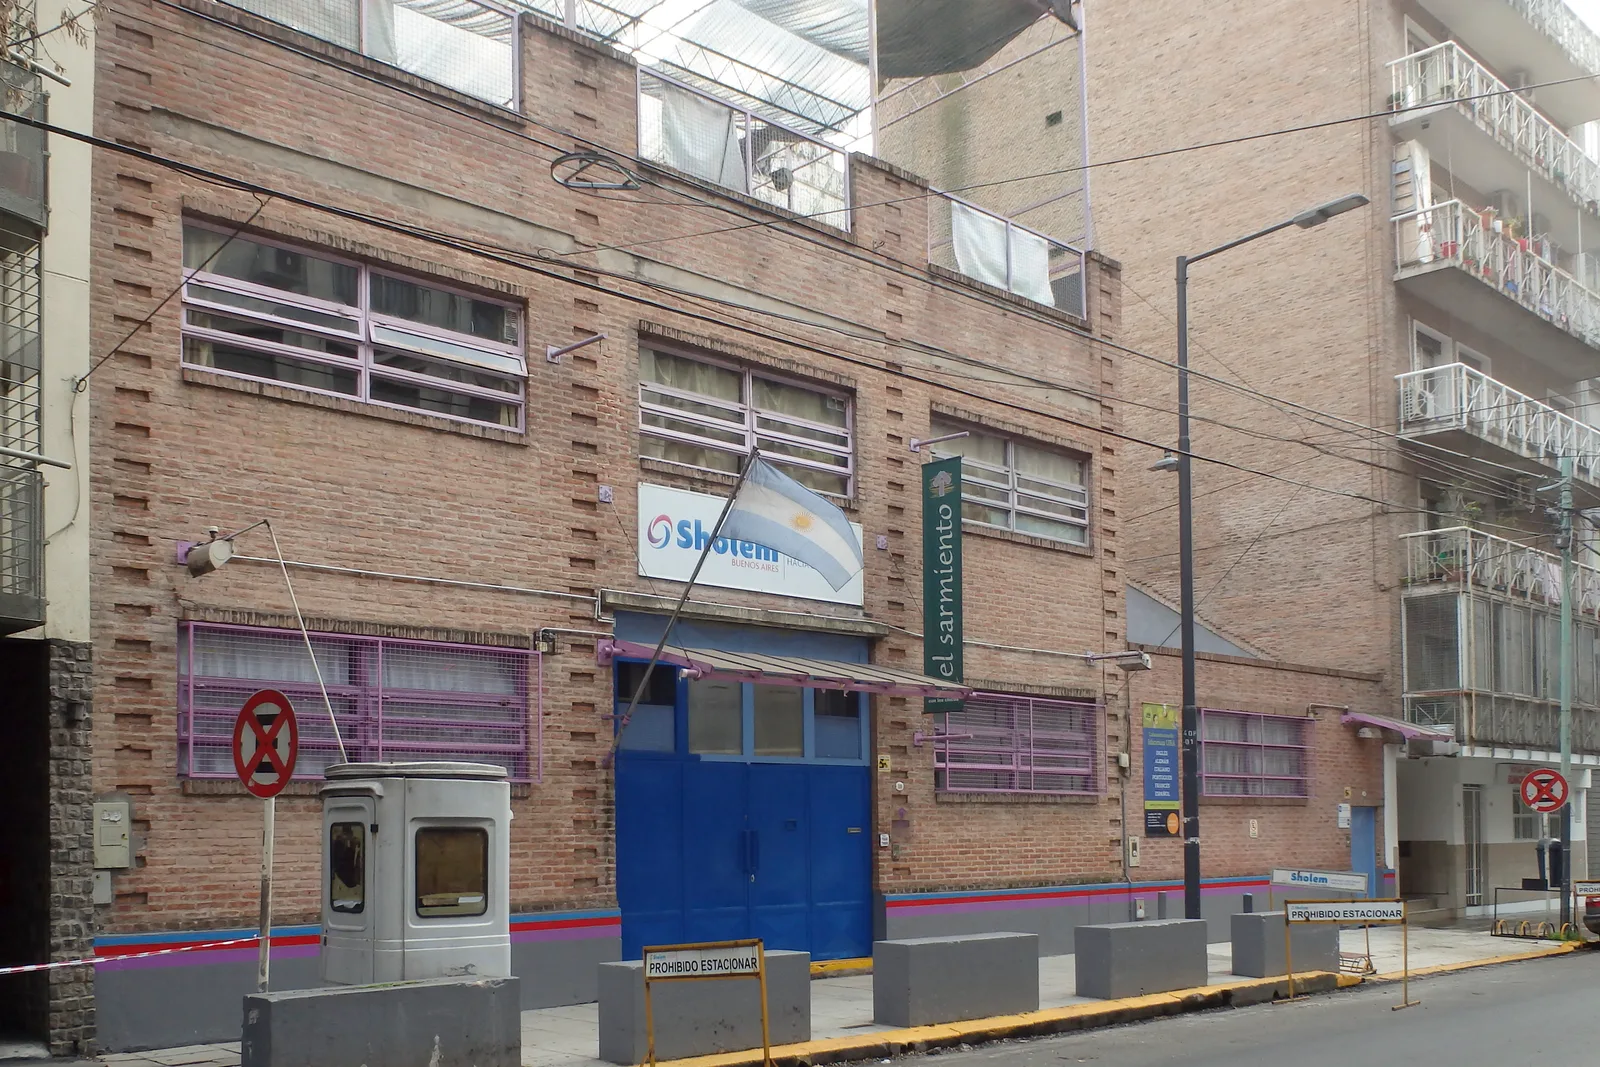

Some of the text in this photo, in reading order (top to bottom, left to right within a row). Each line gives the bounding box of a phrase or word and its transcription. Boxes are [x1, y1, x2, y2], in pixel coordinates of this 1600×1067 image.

[731, 558, 779, 573] BUENOS AIRES
[932, 503, 954, 677] el sarmiento
[1290, 871, 1328, 884] Sholem
[1291, 909, 1402, 919] PROHIBIDO ESTACIONAR
[649, 957, 758, 974] PROHIBIDO ESTACIONAR
